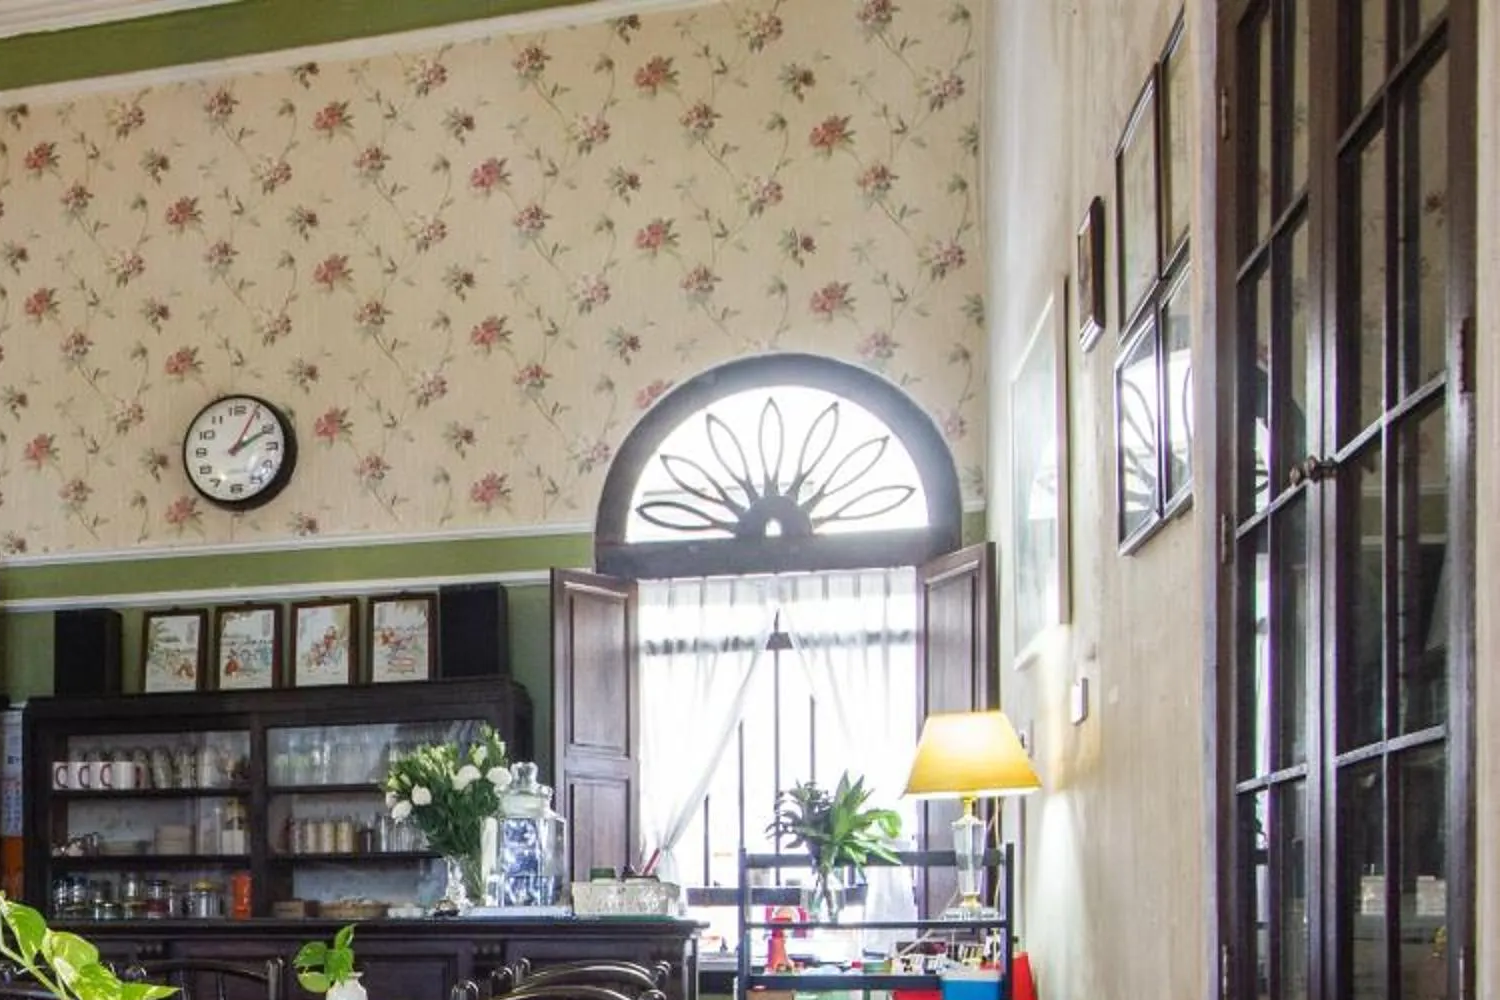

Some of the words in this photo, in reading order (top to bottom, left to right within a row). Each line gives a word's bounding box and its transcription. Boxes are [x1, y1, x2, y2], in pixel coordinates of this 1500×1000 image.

[228, 405, 247, 416] 12
[211, 415, 223, 425] 11
[199, 429, 216, 440] 10
[209, 478, 221, 488] 7
